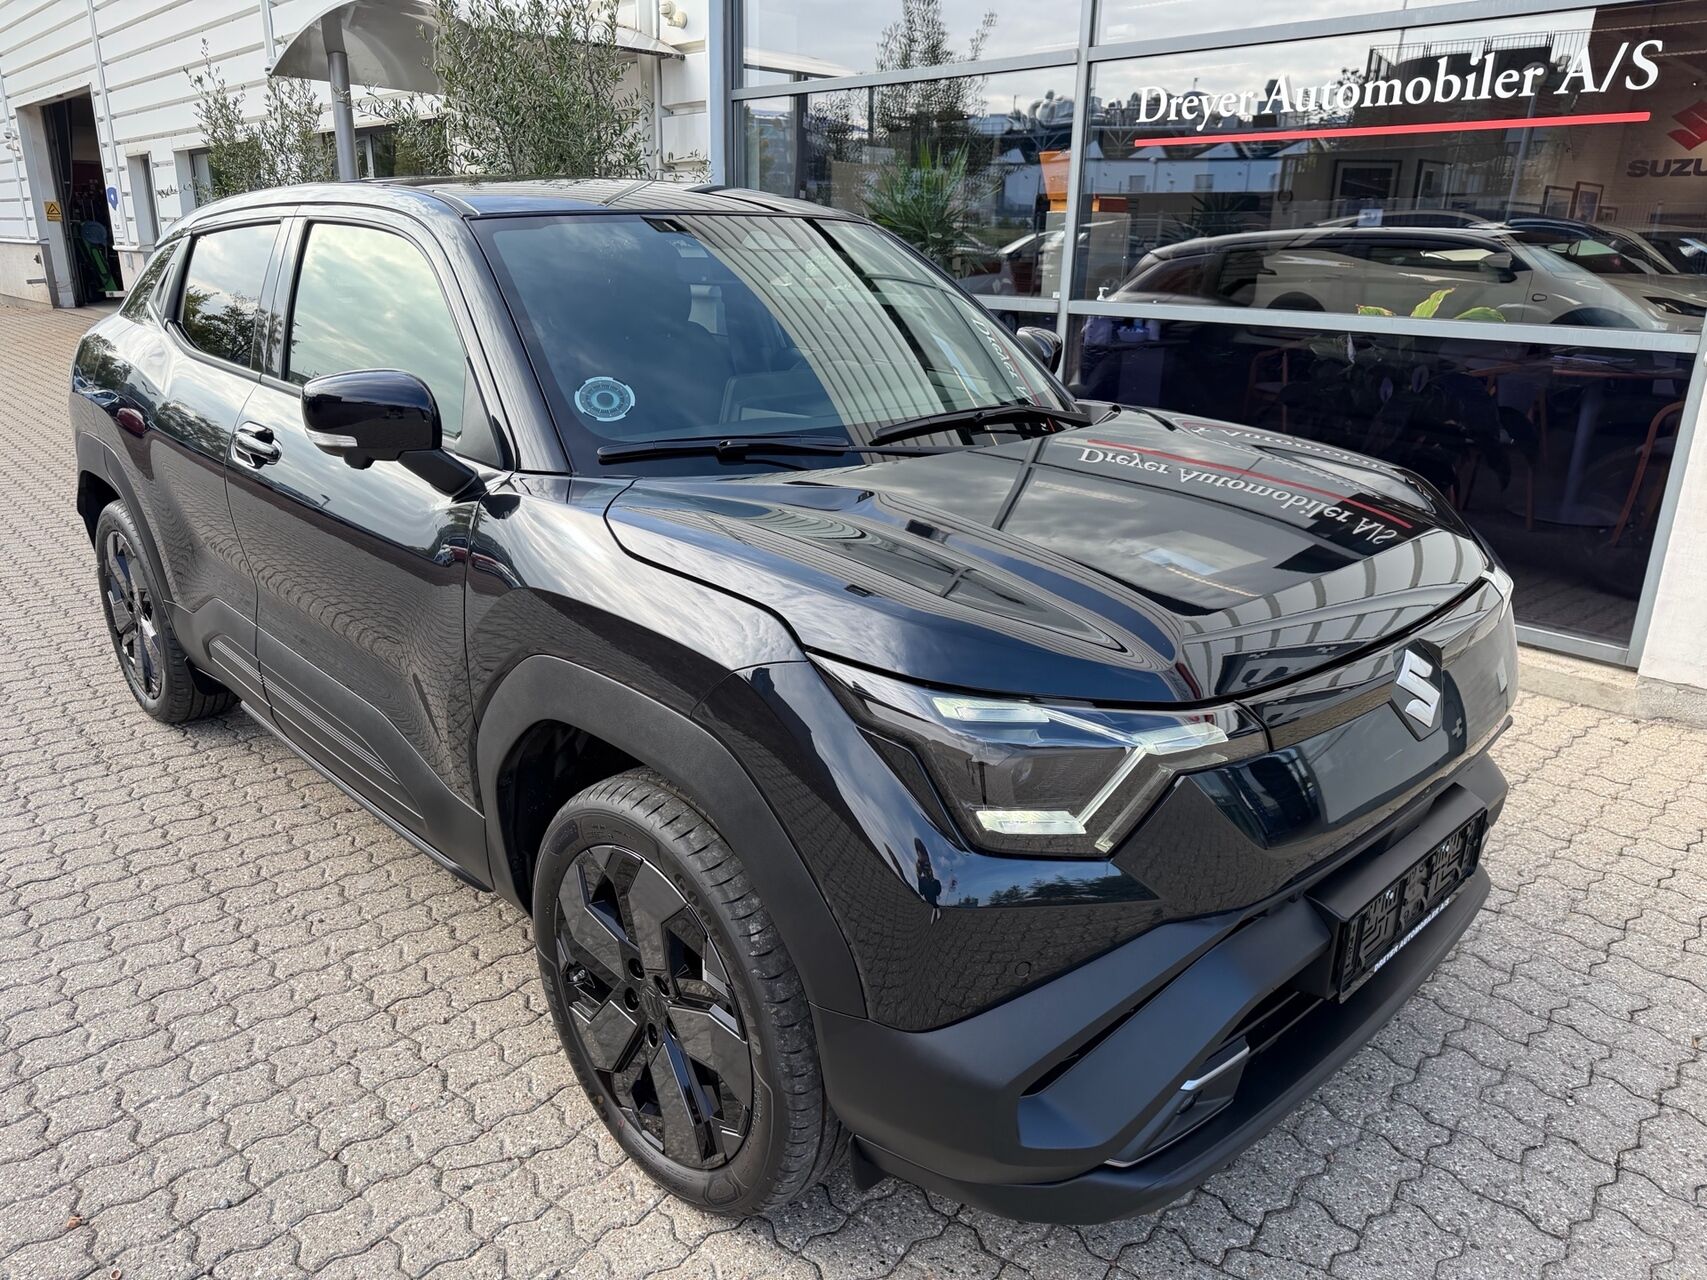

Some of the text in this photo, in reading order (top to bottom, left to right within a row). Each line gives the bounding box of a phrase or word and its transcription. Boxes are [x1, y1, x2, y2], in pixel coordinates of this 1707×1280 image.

[1136, 39, 1663, 132] Dreyer Automobiler A/S
